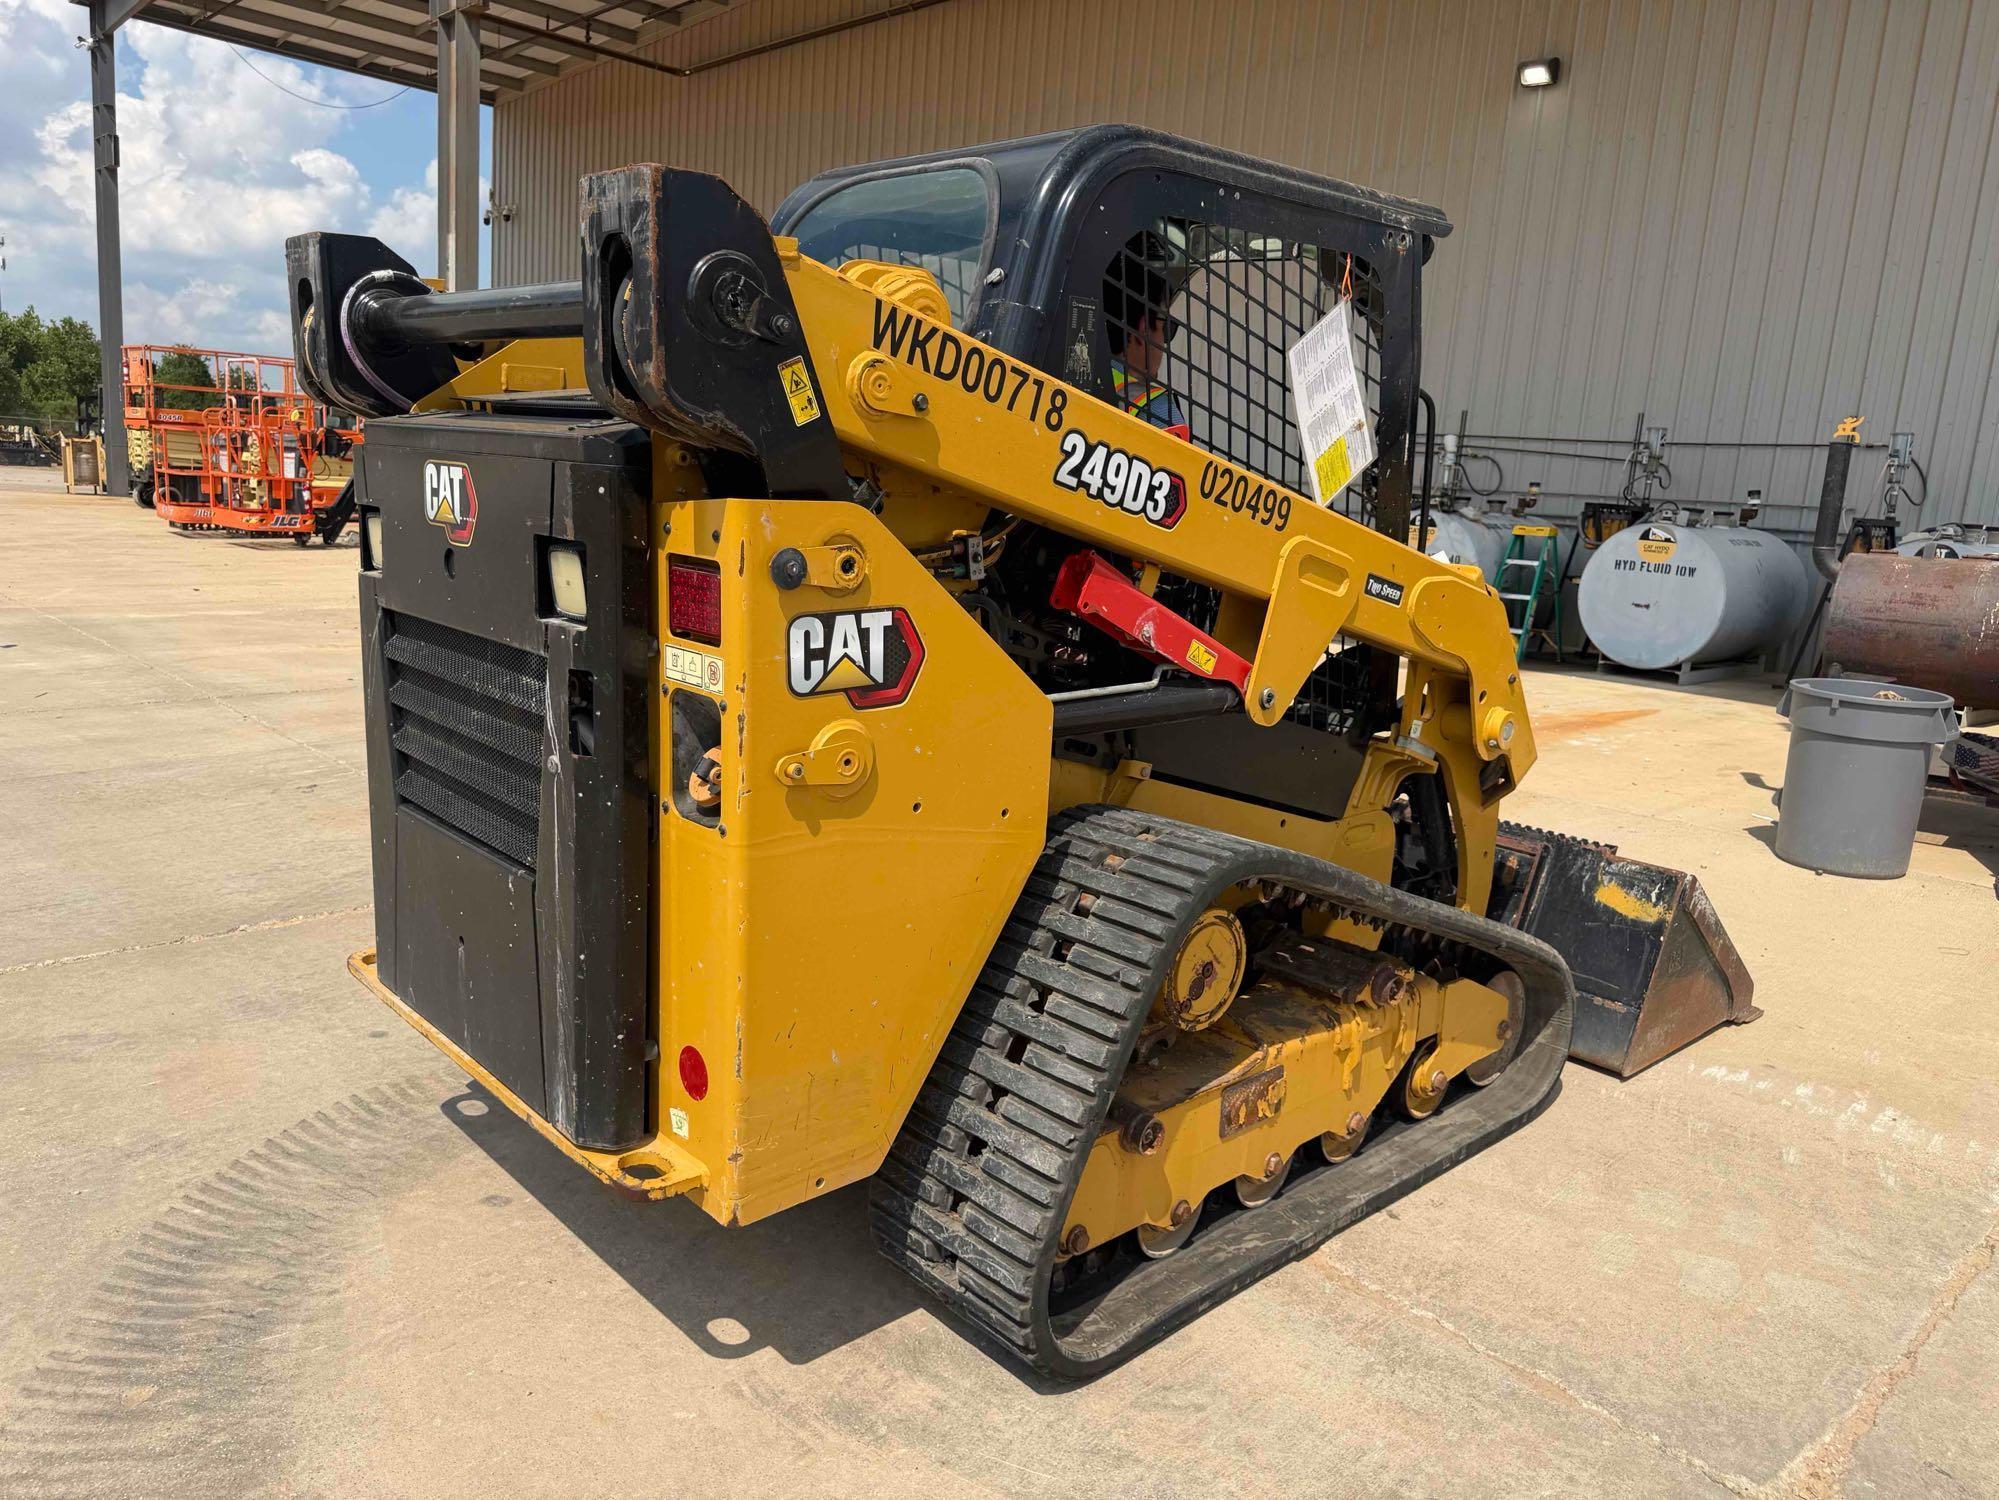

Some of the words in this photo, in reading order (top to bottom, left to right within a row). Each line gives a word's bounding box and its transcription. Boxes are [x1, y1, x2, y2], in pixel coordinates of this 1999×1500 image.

[872, 297, 1068, 432] WKD00718
[425, 463, 463, 525] CAT
[1055, 432, 1171, 522] 249D3
[1199, 458, 1293, 533] 020499
[270, 515, 301, 527] JLG
[1614, 559, 1636, 571] HYD
[1639, 561, 1672, 575] FLUID
[789, 610, 893, 694] CAT
